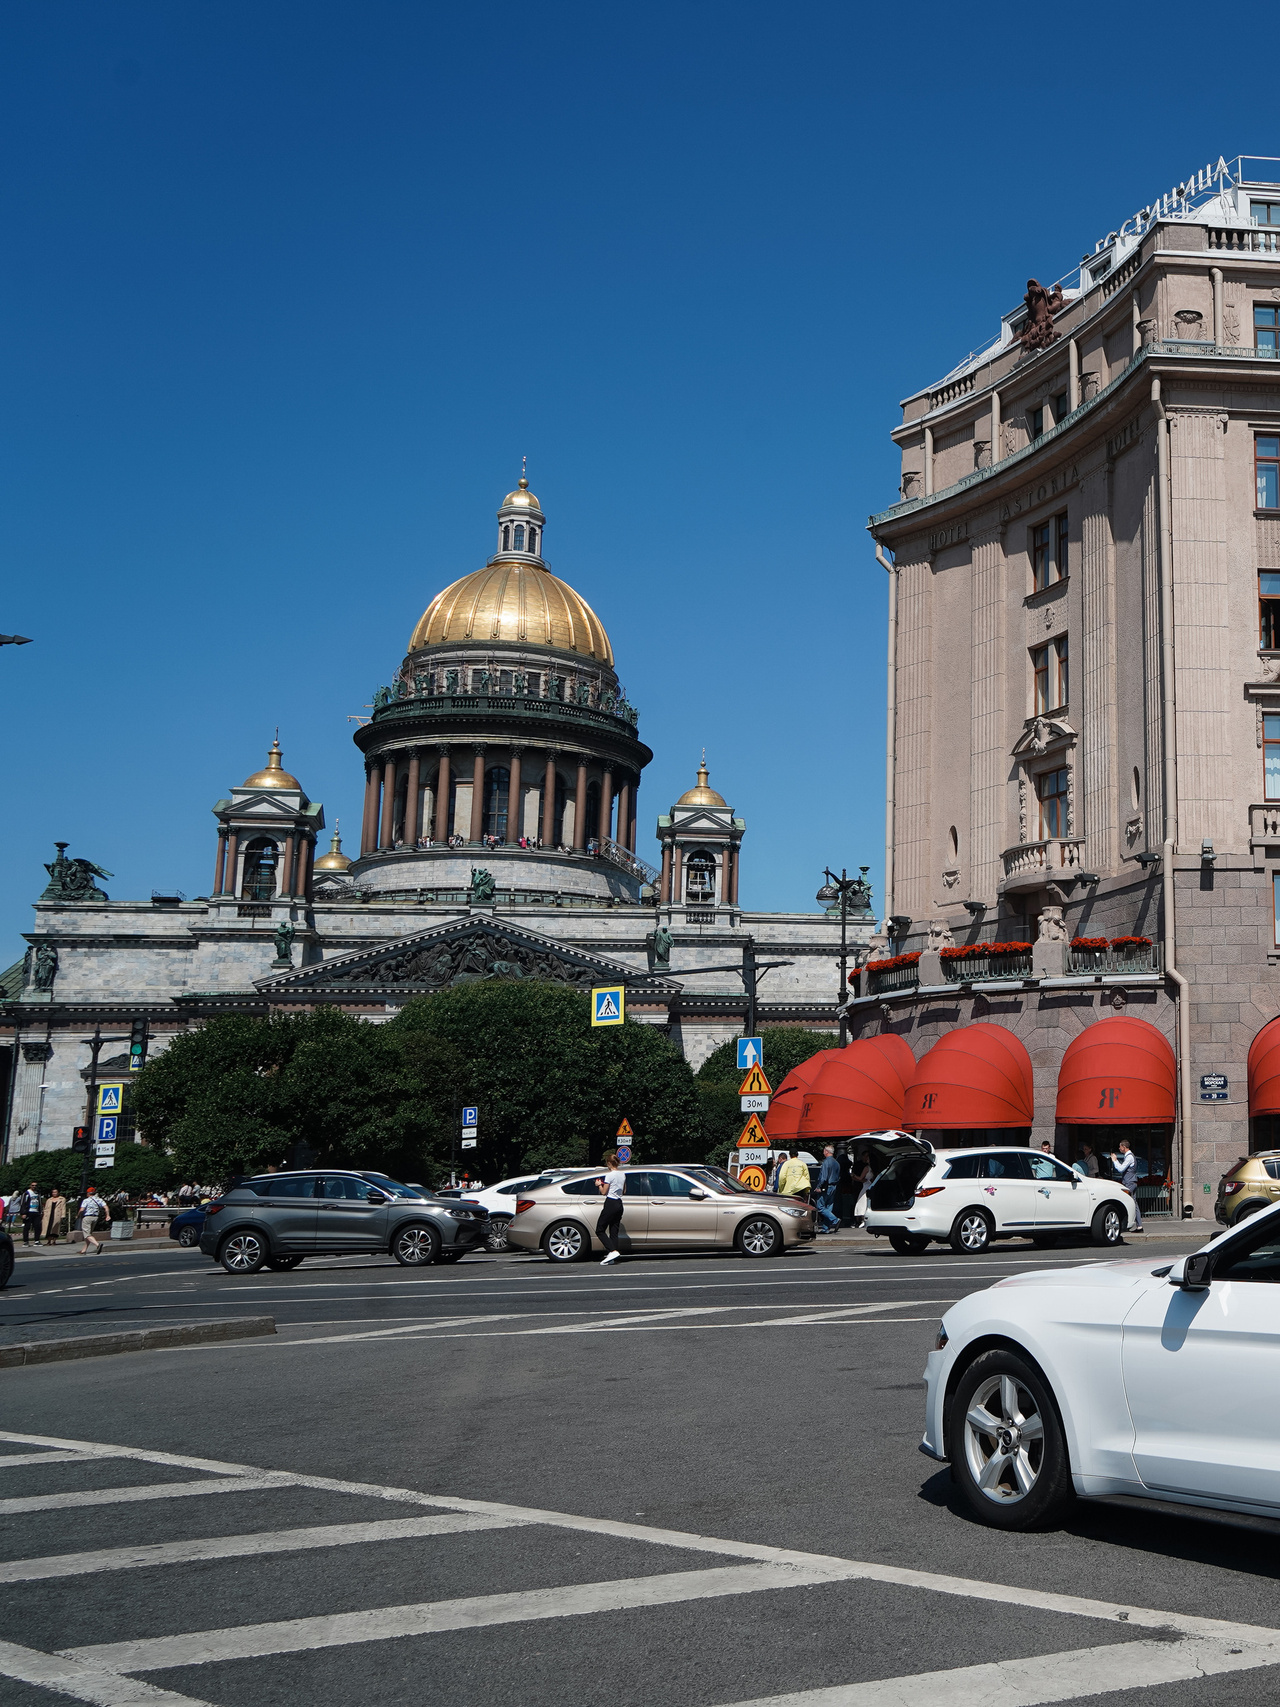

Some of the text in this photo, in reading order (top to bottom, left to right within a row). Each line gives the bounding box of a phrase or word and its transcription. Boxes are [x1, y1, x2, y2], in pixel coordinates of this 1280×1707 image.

[747, 1100, 763, 1108] 30м
[745, 1153, 761, 1161] 30м
[745, 1175, 760, 1188] 40
